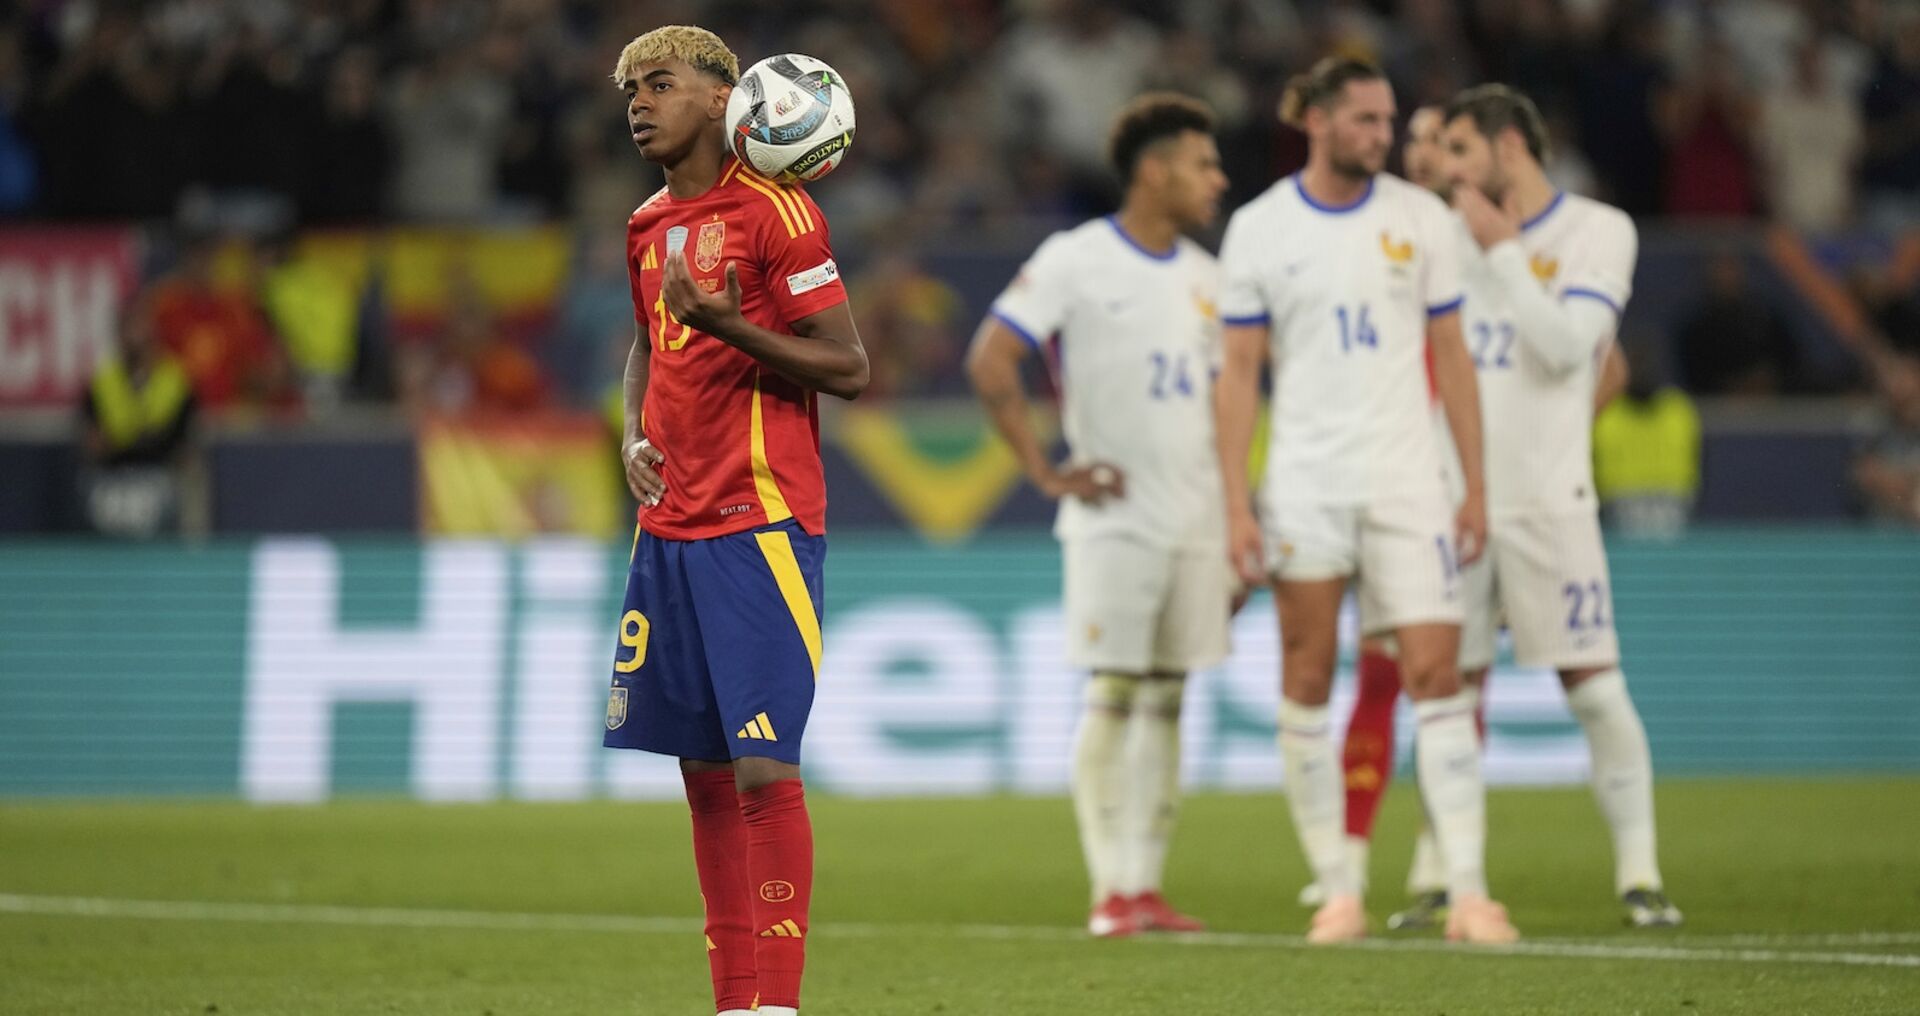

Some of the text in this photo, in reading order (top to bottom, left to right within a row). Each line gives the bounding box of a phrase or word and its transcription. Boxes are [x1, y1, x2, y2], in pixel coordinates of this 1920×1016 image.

[794, 138, 841, 172] NATIONS
[1335, 304, 1379, 352] 14
[1473, 321, 1516, 369] 22
[1148, 350, 1194, 400] 24
[1563, 580, 1610, 631] 22
